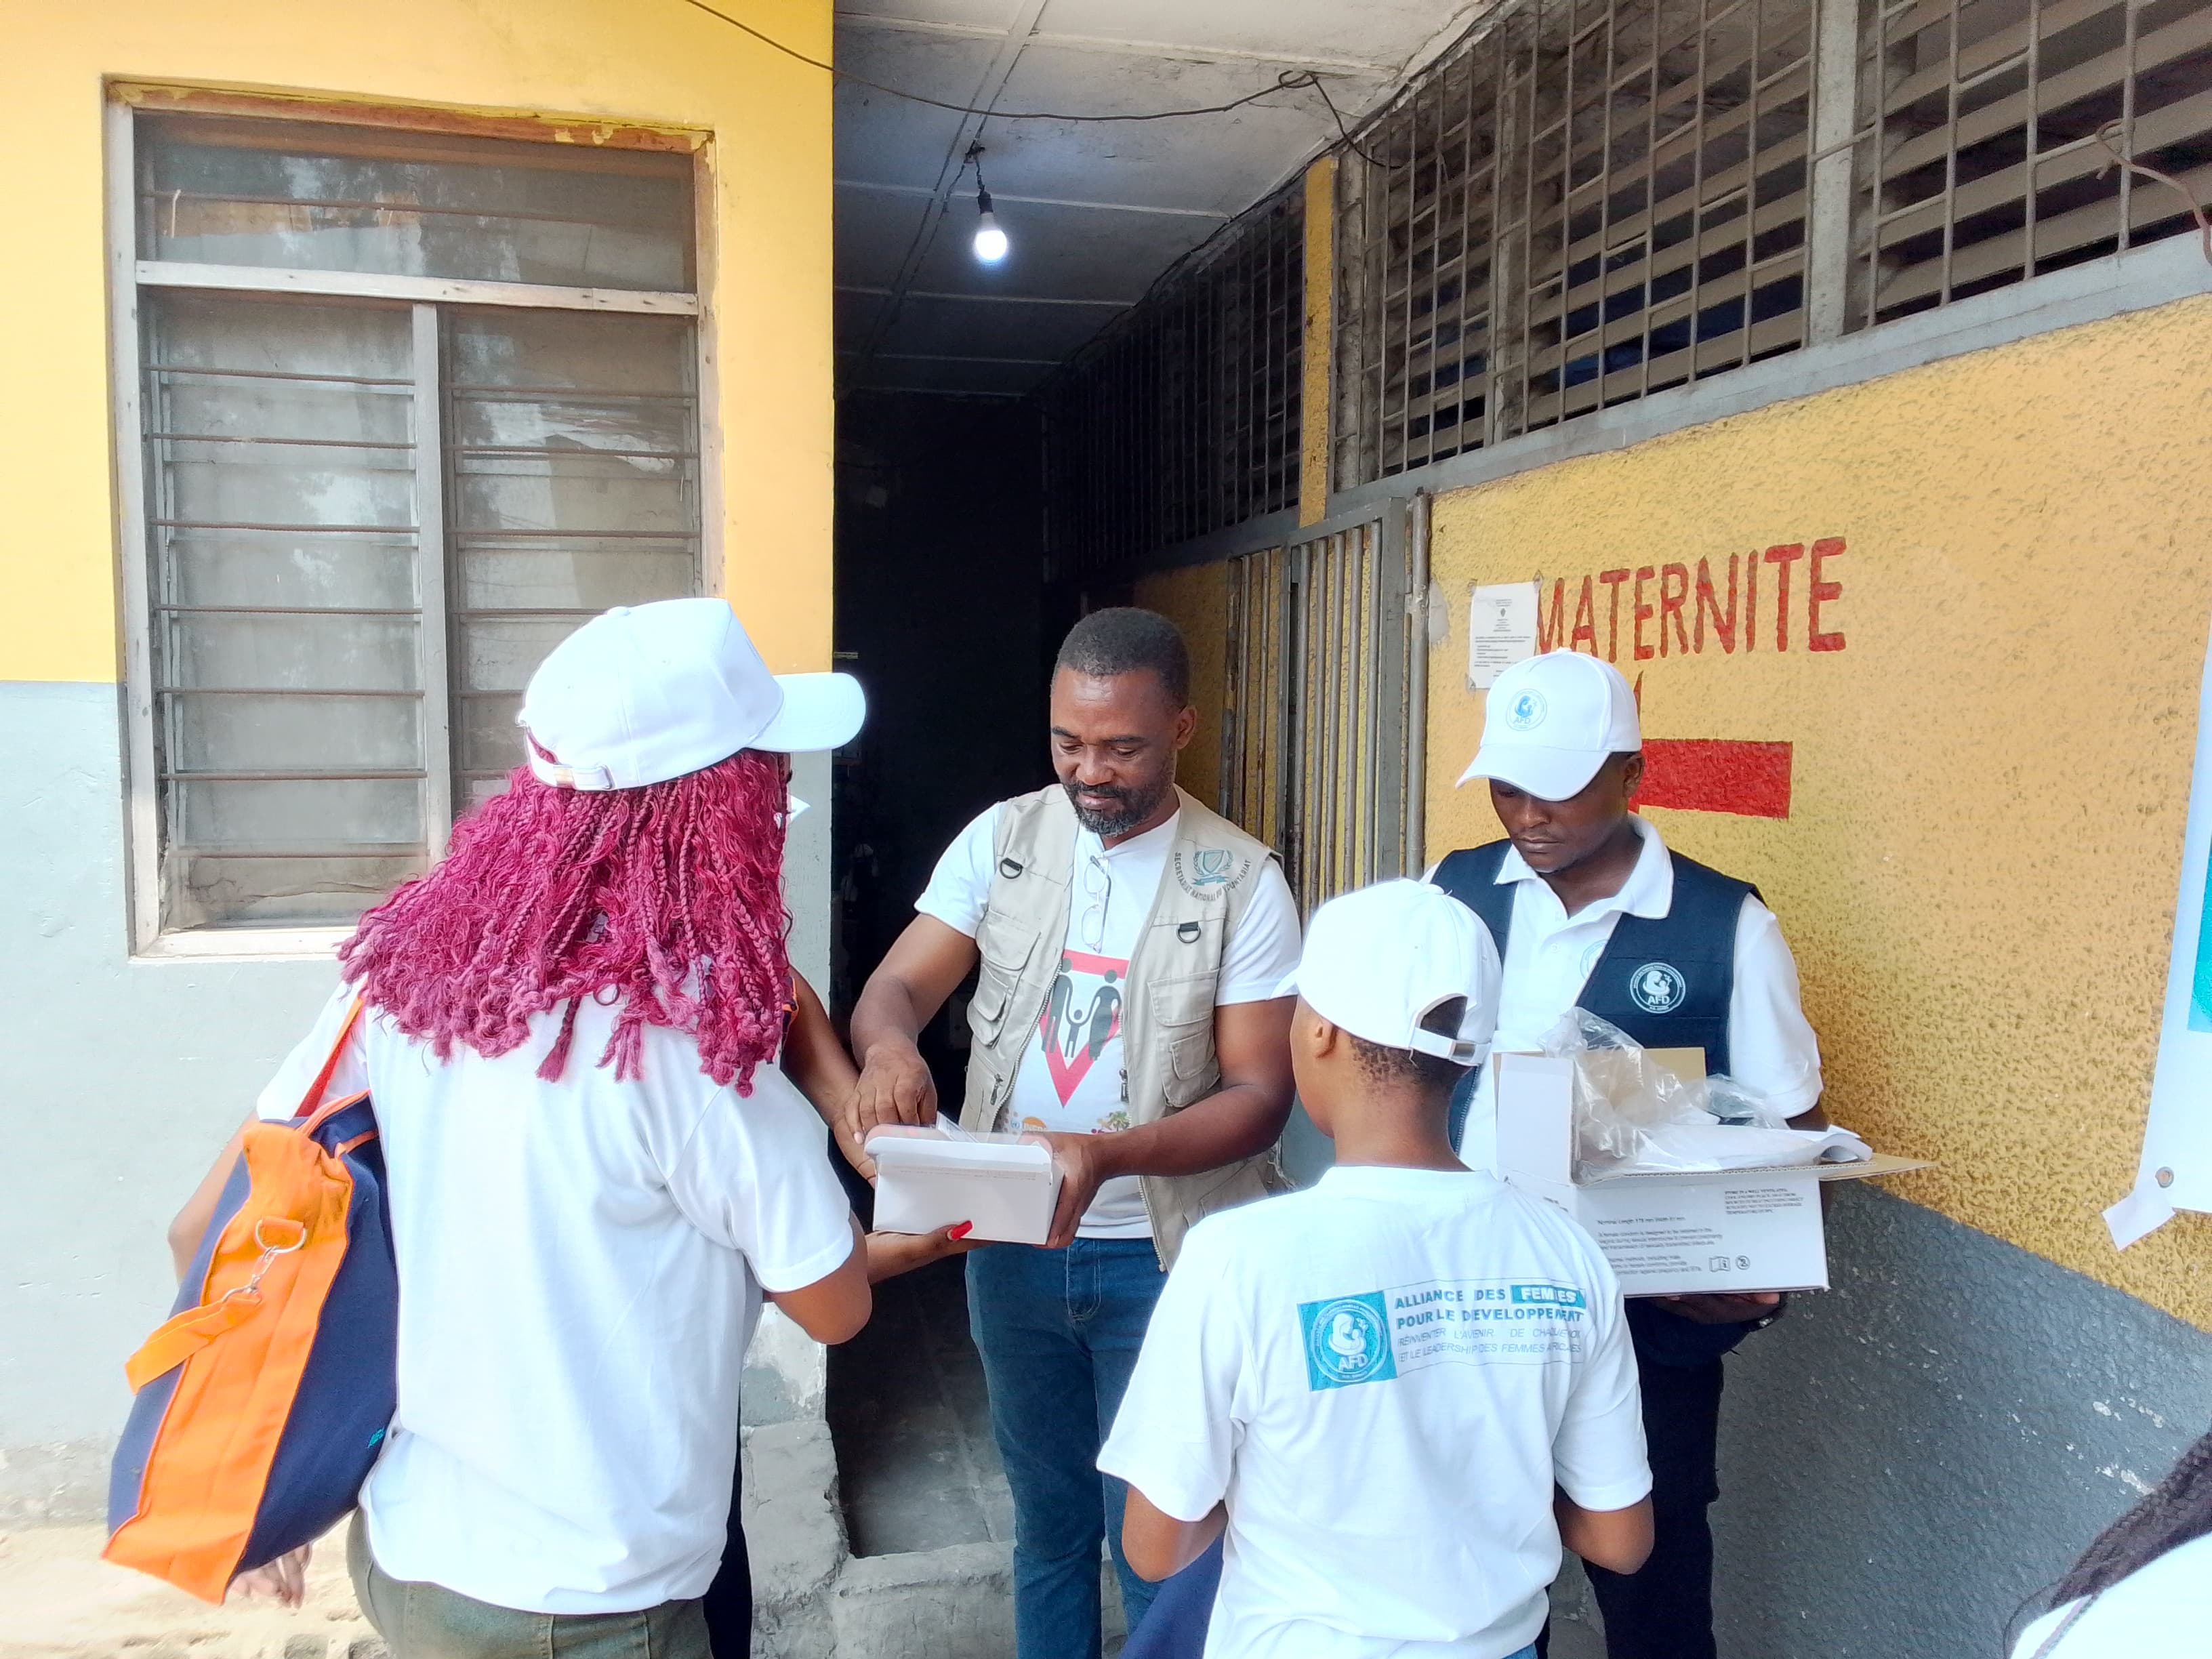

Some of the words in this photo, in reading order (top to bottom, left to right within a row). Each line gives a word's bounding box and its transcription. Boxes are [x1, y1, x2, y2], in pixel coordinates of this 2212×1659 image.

[1538, 536, 1847, 663] MATERNITE
[1174, 852, 1193, 894] SECRETARIAT
[1647, 996, 1671, 1005] AFD
[1395, 1289, 1464, 1309] ALLIANCE
[1474, 1289, 1506, 1301] DES
[1520, 1287, 1578, 1304] FEMES
[1396, 1311, 1434, 1329] POUR
[1436, 1309, 1456, 1322] LE
[1510, 1328, 1525, 1338] DE
[1410, 1348, 1421, 1359] LE
[1502, 1343, 1546, 1353] FEMMES
[1338, 1353, 1368, 1372] AFD
